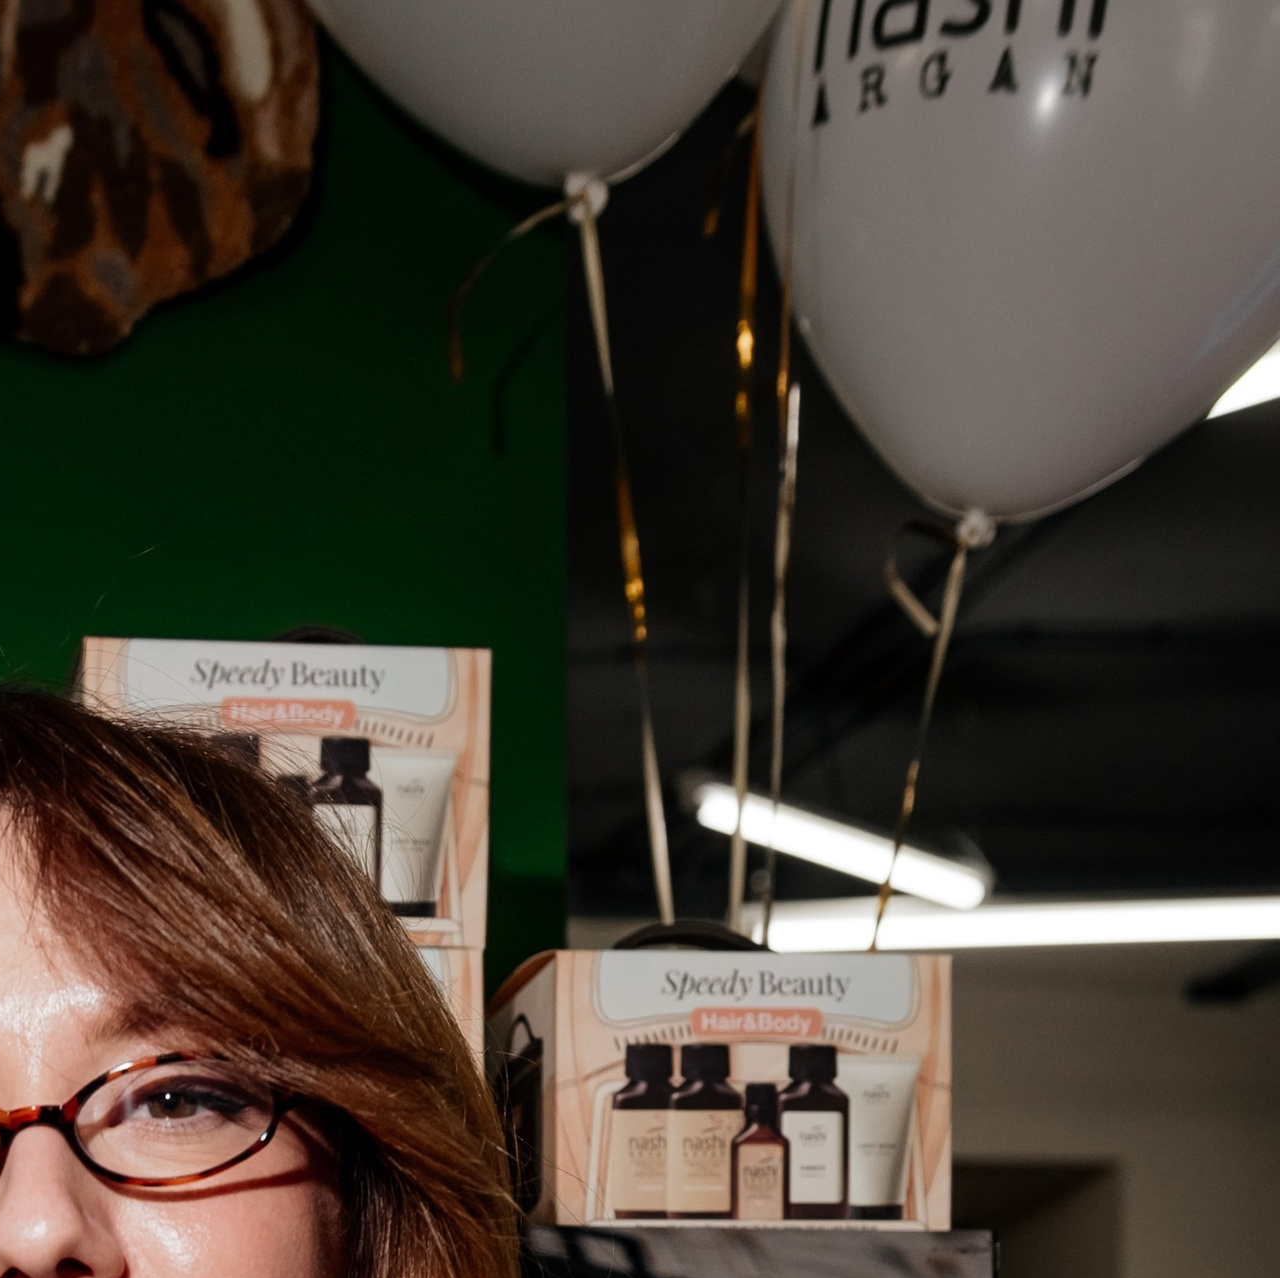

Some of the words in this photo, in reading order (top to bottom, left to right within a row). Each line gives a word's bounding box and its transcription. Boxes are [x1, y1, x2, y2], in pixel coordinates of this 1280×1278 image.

[812, 46, 1098, 128] ARGAN
[190, 658, 286, 690] Speedy
[291, 661, 385, 694] Beauty
[231, 701, 345, 727] Hair&Body
[660, 968, 754, 1002] Speedy
[758, 970, 851, 1001] Beauty
[700, 1012, 813, 1037] Hair&Body
[628, 1133, 667, 1151] nash
[683, 1132, 727, 1151] nashi
